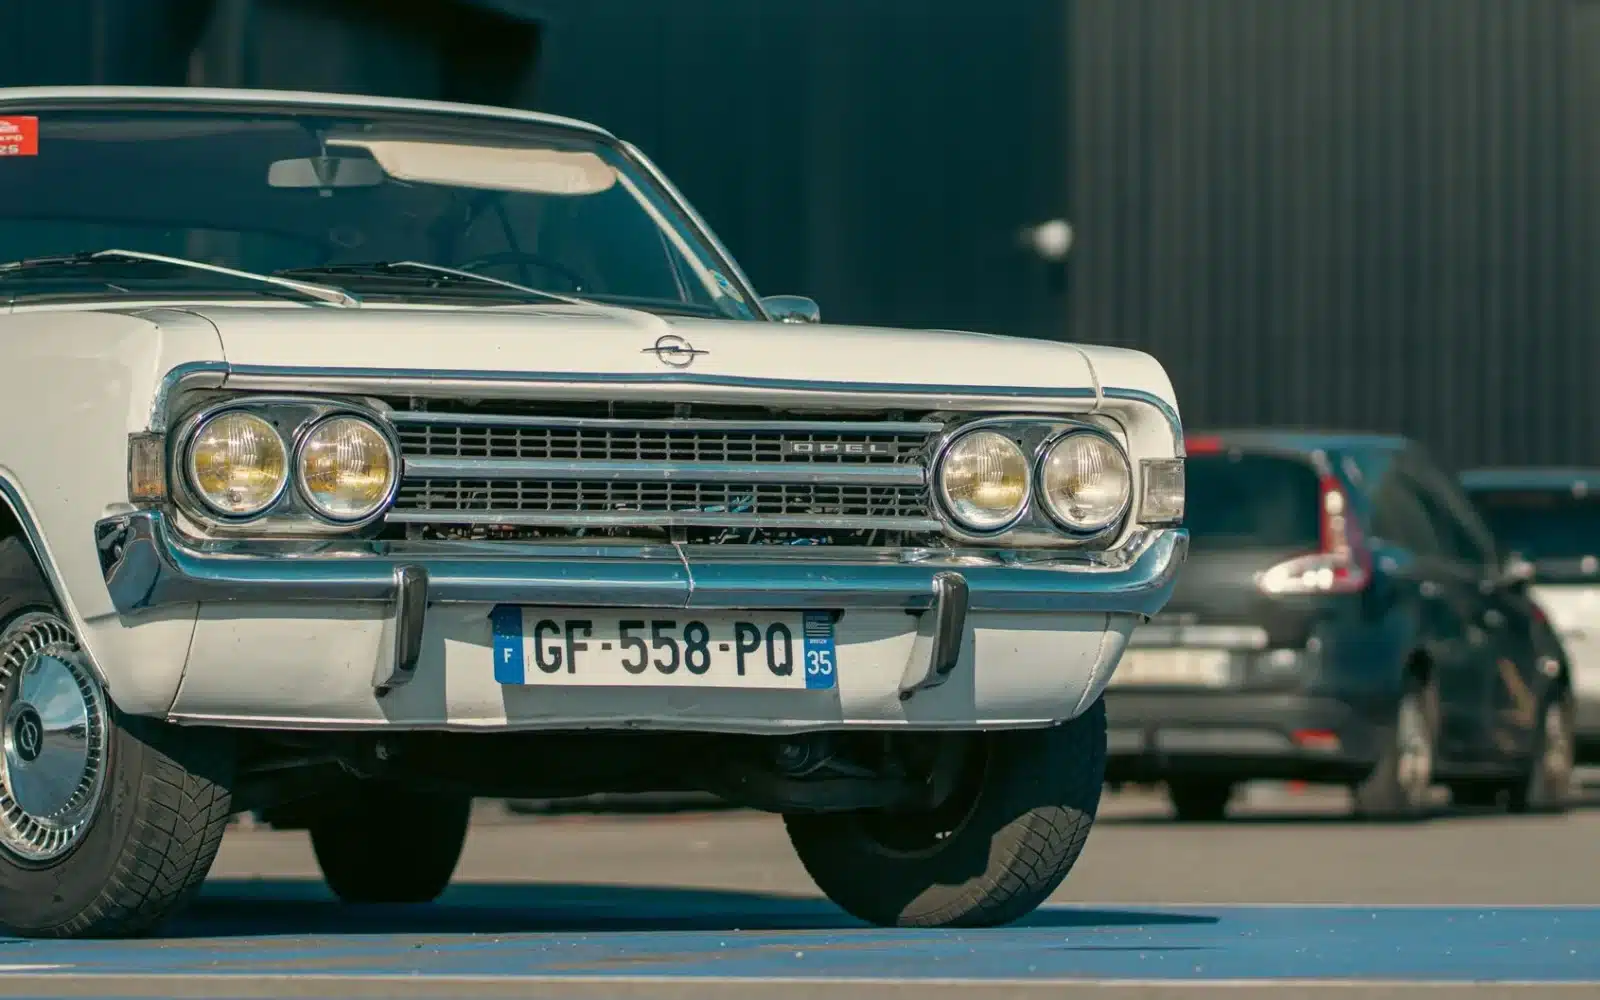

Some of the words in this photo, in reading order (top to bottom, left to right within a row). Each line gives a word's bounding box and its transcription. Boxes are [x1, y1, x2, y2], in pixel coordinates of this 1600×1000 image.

[793, 443, 887, 453] OPEL
[503, 647, 513, 663] F
[534, 619, 794, 677] GF-558-PQ
[807, 650, 832, 675] 35
